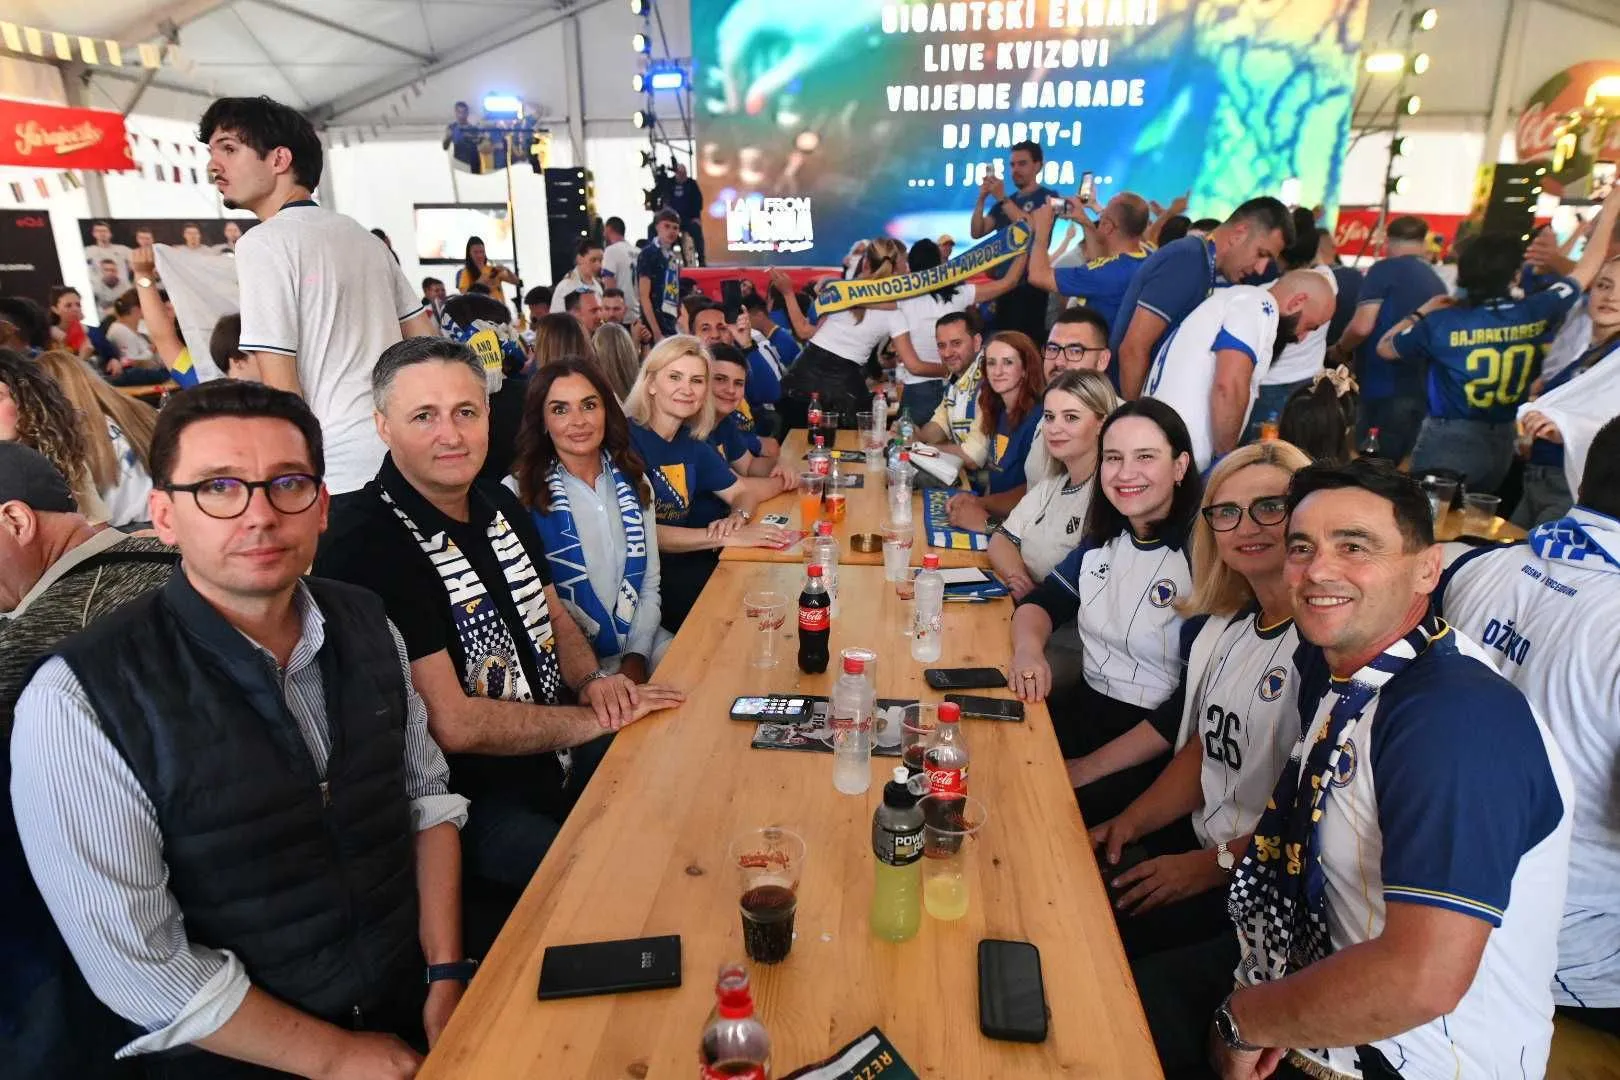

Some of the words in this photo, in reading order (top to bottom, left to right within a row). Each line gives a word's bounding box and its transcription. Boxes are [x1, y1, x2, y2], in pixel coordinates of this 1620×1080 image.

[924, 43, 985, 72] LIVE
[996, 39, 1110, 71] KVIZOVI
[886, 83, 1011, 112] VRIJEDNE
[1021, 79, 1146, 108] NAGRADE
[942, 123, 970, 149] DJ
[1464, 343, 1535, 408] 20
[1205, 704, 1242, 771] 26
